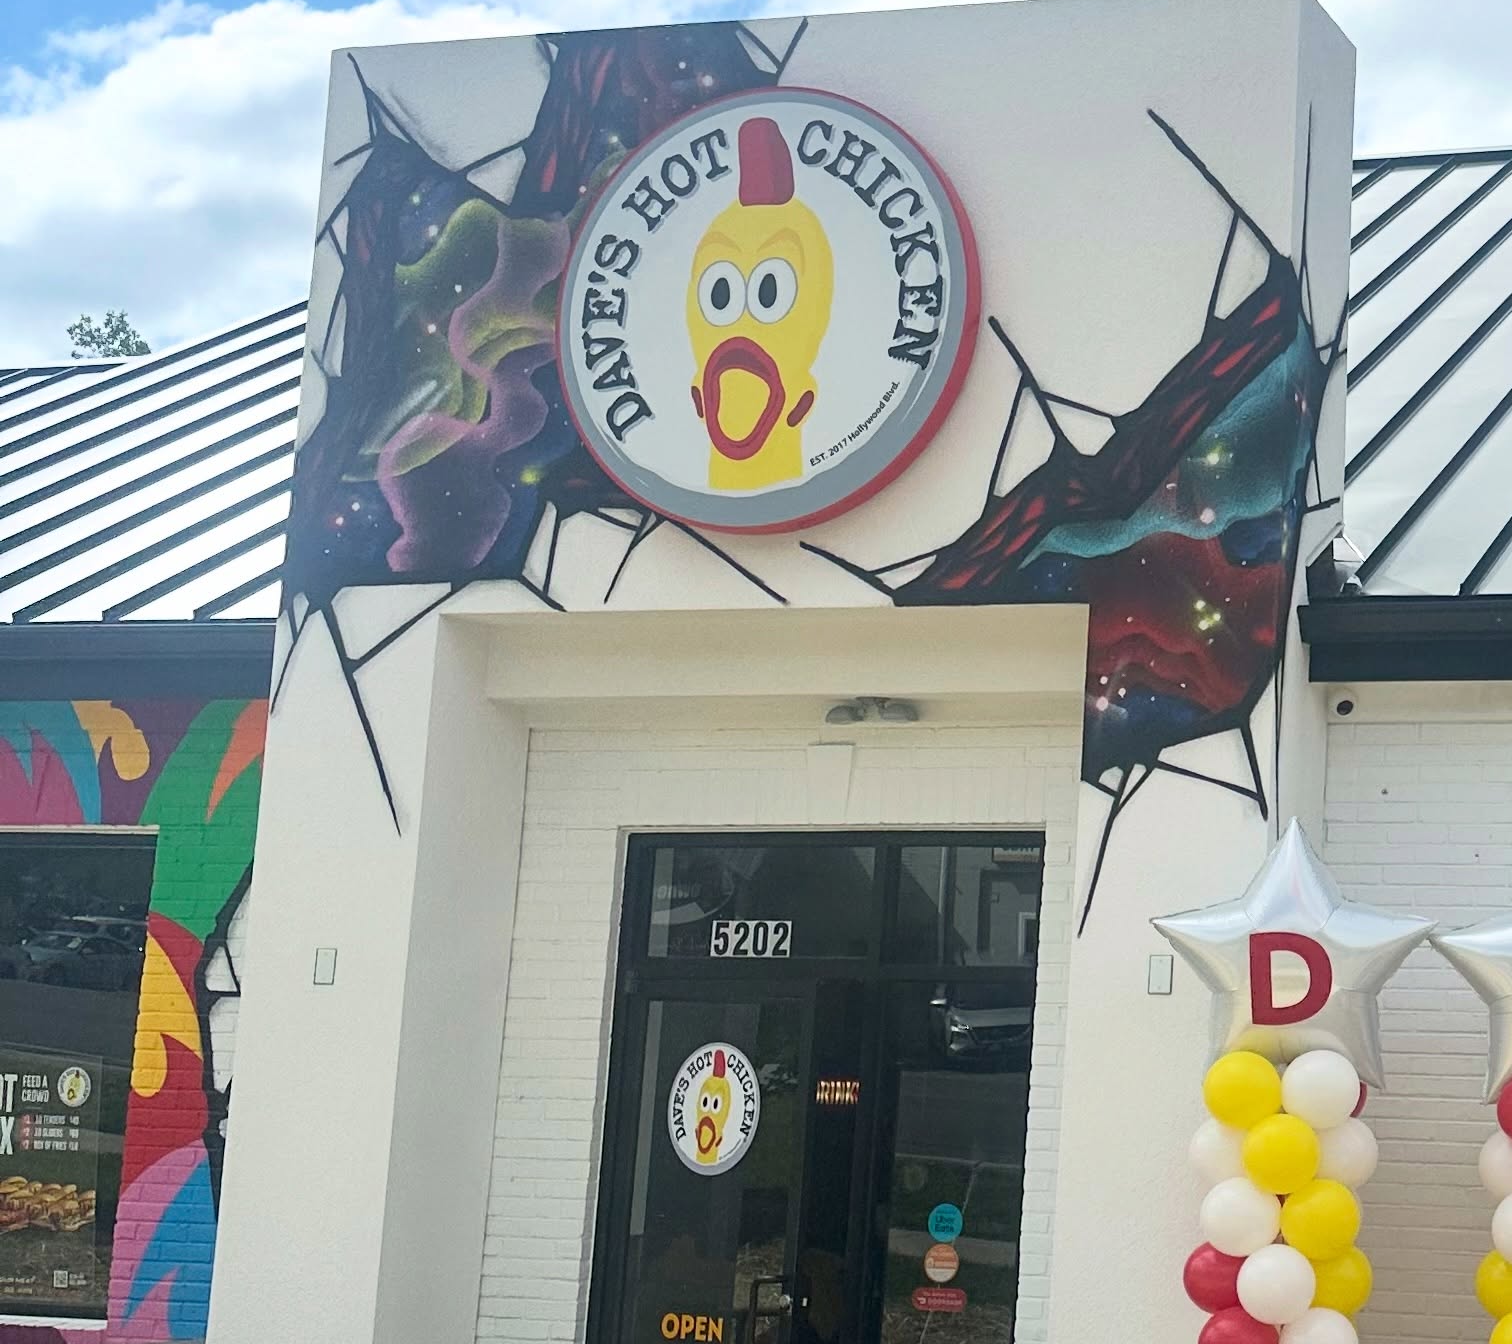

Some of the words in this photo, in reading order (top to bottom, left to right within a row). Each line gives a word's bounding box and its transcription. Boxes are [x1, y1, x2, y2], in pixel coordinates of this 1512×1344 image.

[582, 234, 656, 442] DAVE'S
[621, 128, 731, 232] HOT
[796, 119, 943, 371] CHICKEN
[809, 453, 828, 466] EST.
[828, 438, 848, 456] 2017
[847, 401, 885, 442] Hollywood
[882, 381, 900, 402] Blvd.
[713, 921, 789, 956] 5202
[21, 1089, 49, 1103] CROWD
[22, 1074, 41, 1088] FEED
[41, 1074, 48, 1088] A
[673, 1077, 690, 1141] DAVE'S
[687, 1051, 712, 1079] HOT
[727, 1054, 755, 1137] CHICKEN
[661, 1312, 724, 1343] OPEN
